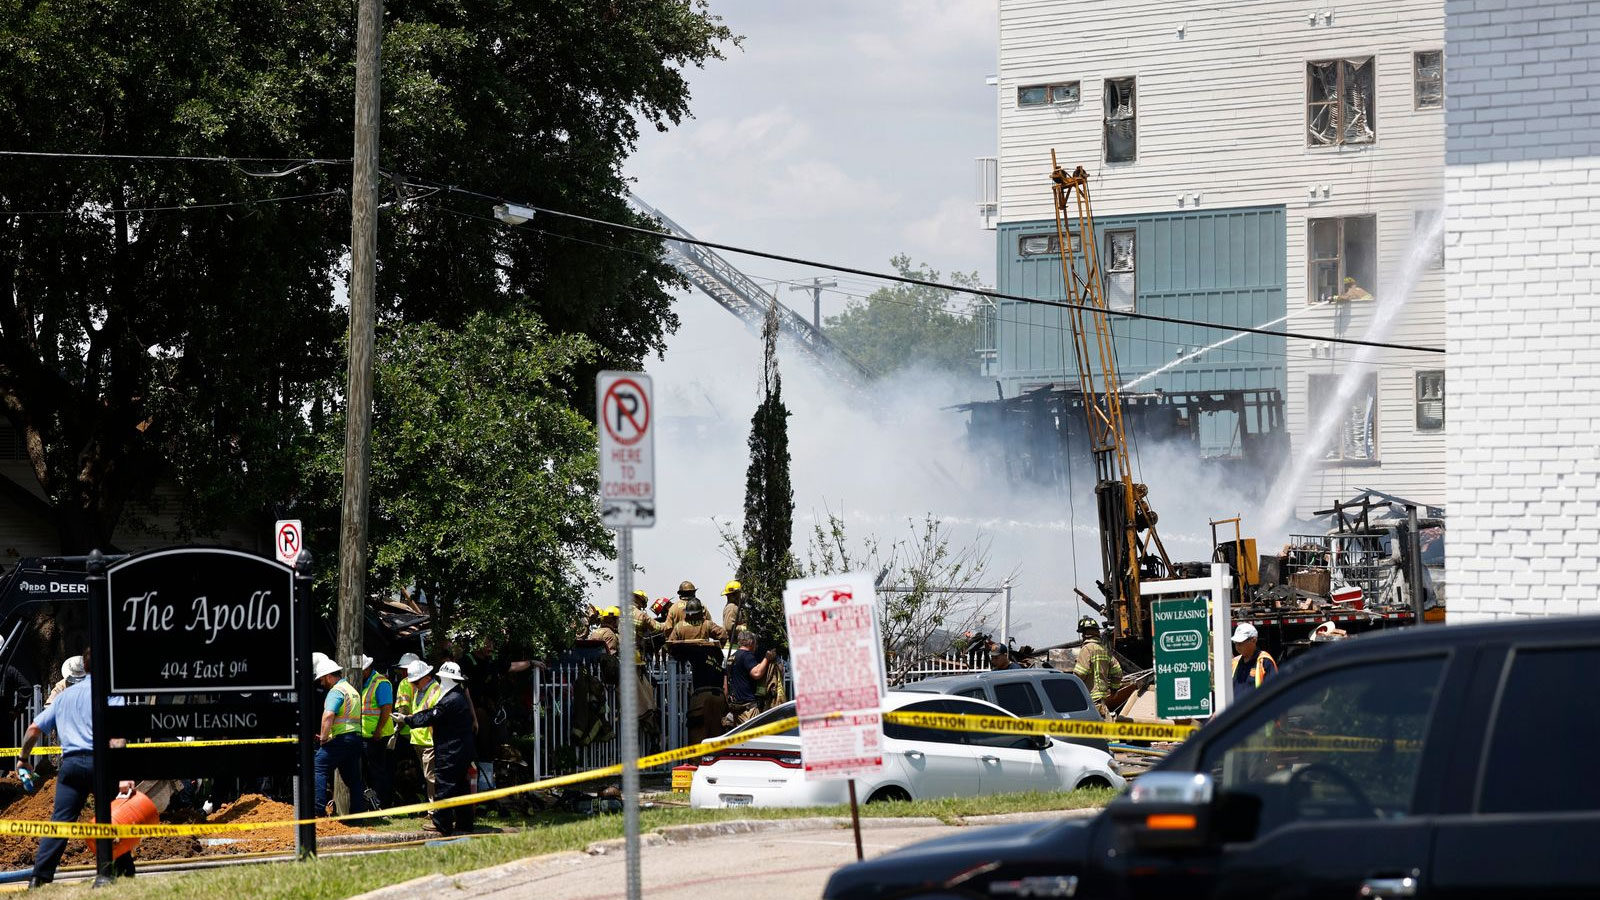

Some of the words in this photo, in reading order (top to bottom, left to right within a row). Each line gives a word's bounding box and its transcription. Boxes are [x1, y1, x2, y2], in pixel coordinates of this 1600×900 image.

[611, 448, 642, 463] HERE
[621, 466, 635, 479] TO
[605, 482, 651, 497] CORNER
[50, 581, 88, 593] DEER
[122, 590, 175, 631] The
[184, 590, 281, 644] Apollo
[1155, 611, 1173, 621] NOW
[1174, 609, 1206, 619] LEASING
[1165, 635, 1175, 643] THE
[1176, 634, 1197, 643] APOLLO
[160, 661, 188, 679] 404
[193, 660, 224, 678] East
[229, 659, 248, 678] 9th
[1157, 661, 1207, 674] 844-629-7910
[151, 712, 190, 729] NOW
[194, 711, 258, 729] LEASING
[912, 714, 966, 728] CAUTION
[979, 718, 1035, 731] CAUTION
[1049, 722, 1104, 735] CAUTION
[1117, 725, 1174, 738] CAUTION
[1332, 738, 1386, 749] CAUTIO
[10, 821, 59, 836] CAUTION
[70, 824, 118, 836] CAUTION
[130, 826, 178, 836] CAUTION
